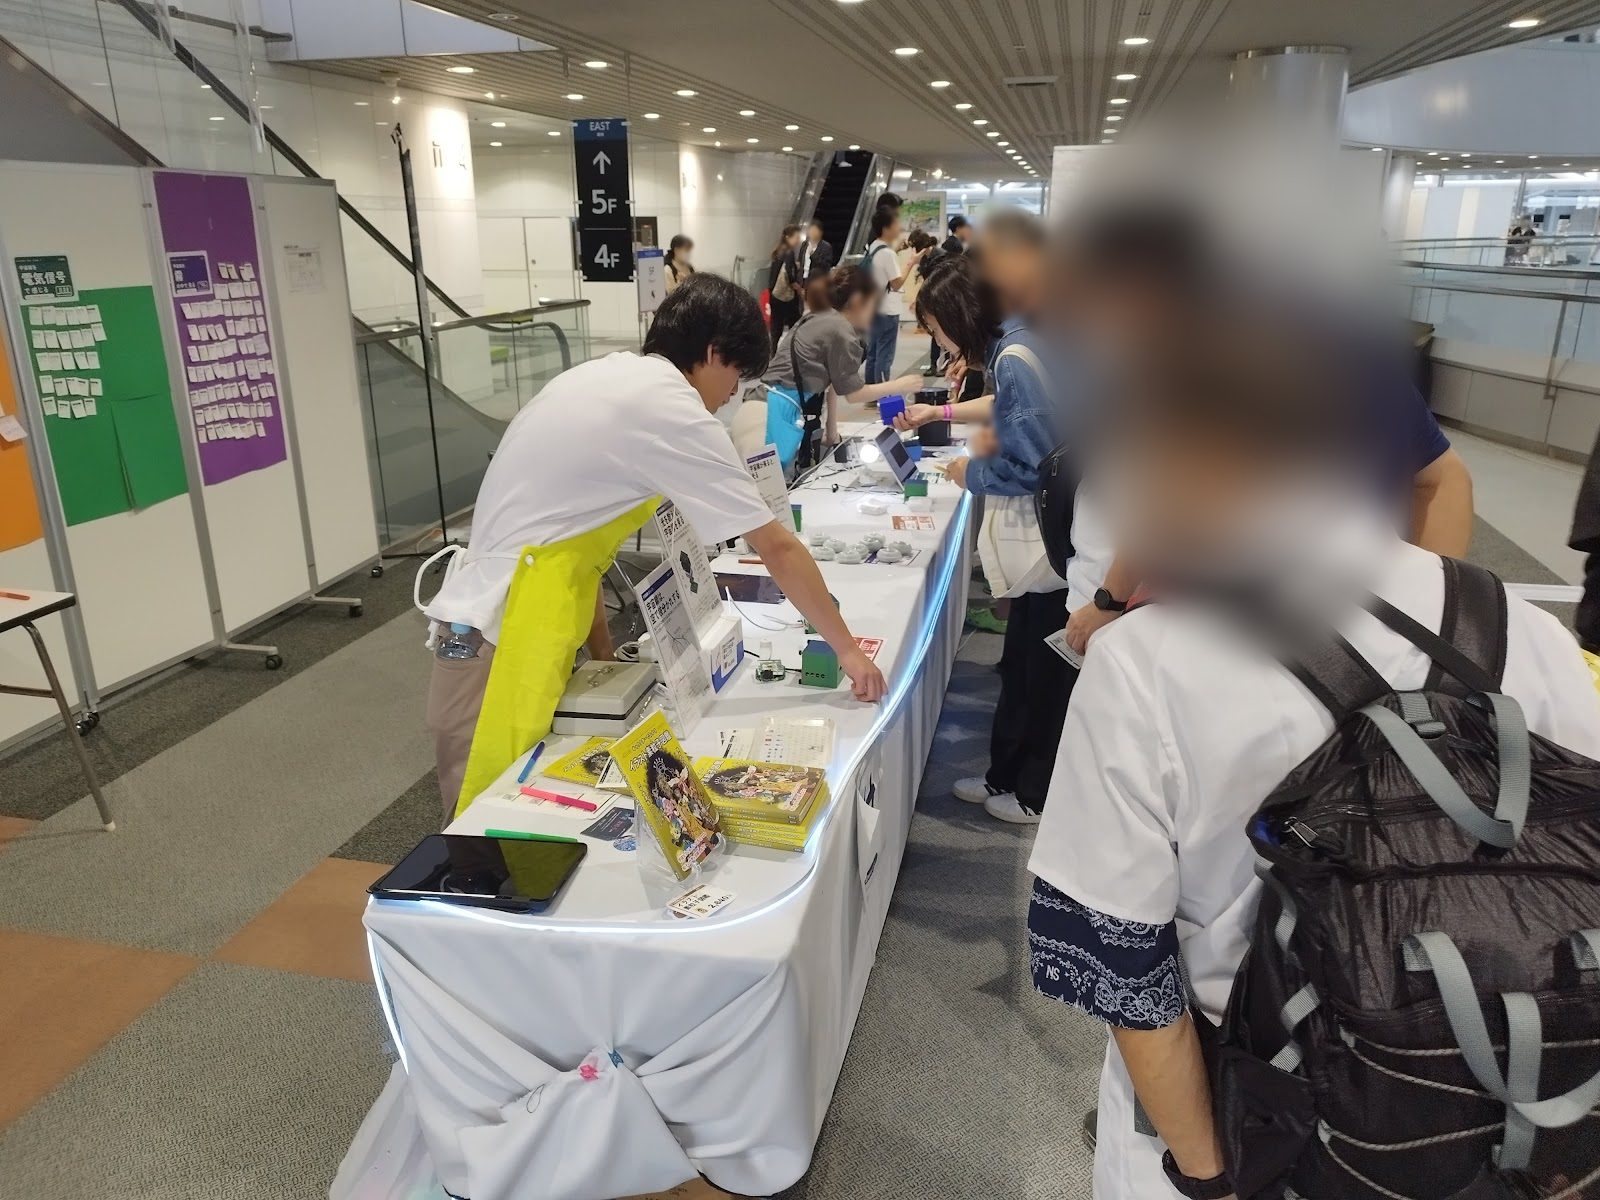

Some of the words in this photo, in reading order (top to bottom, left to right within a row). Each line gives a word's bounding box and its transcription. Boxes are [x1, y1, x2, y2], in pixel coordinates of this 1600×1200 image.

[590, 121, 610, 131] EAST
[592, 189, 617, 215] 5F
[594, 244, 620, 268] 4F
[21, 271, 66, 286] 電気信号
[1046, 965, 1060, 981] NS
